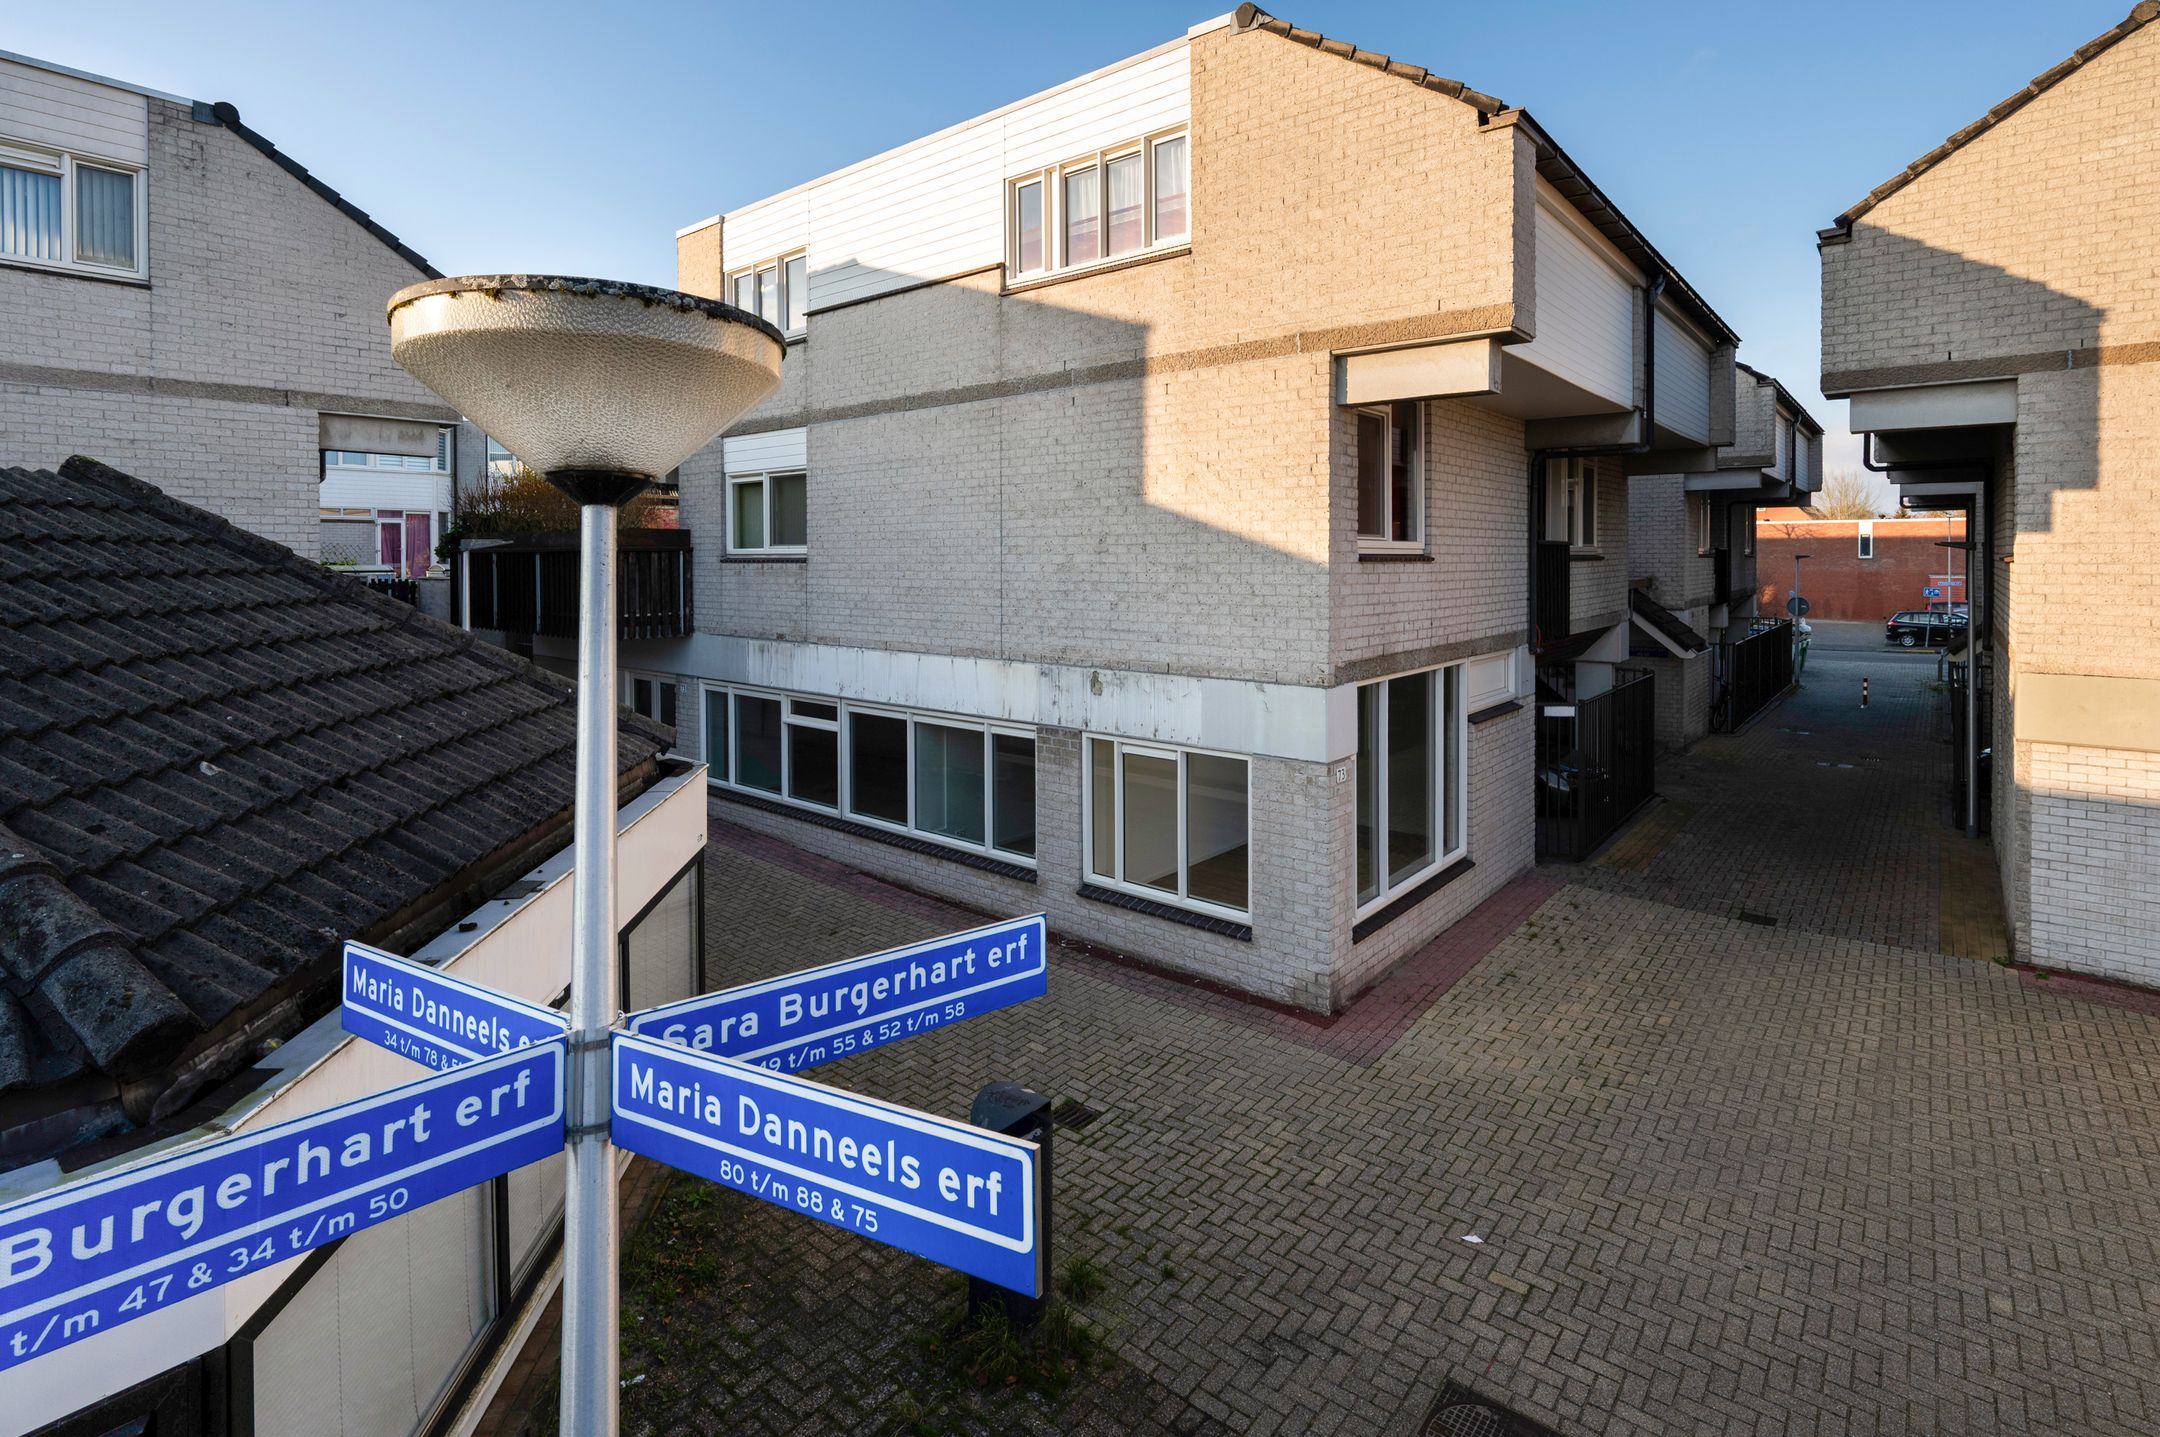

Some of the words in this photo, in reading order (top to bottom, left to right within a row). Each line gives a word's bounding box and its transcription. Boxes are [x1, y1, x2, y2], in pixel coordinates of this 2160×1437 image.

[1337, 768, 1346, 782] 73
[353, 965, 403, 1012] Maria
[412, 986, 510, 1051] Danneels
[662, 1011, 759, 1051] Sara
[779, 946, 976, 1028] Burgerhart
[987, 933, 1028, 968] erf
[788, 1046, 826, 1068] t/m
[833, 1034, 856, 1055] 55
[862, 1029, 874, 1046] &
[879, 1021, 901, 1041] 52
[906, 1012, 939, 1032] t/m
[945, 1001, 965, 1020] 58
[384, 1030, 398, 1049] 34
[400, 1037, 421, 1059] t/m
[423, 1046, 438, 1066] 78
[441, 1054, 449, 1070] &
[0, 1103, 431, 1289] Burgerhart
[455, 1069, 532, 1127] erf
[631, 1062, 721, 1126] Maria
[738, 1094, 921, 1190] Danneels
[938, 1167, 1002, 1216] erf
[720, 1159, 745, 1184] 80
[750, 1170, 789, 1202] t/m
[796, 1186, 823, 1213] 88
[830, 1198, 845, 1222] &
[851, 1203, 879, 1233] 75
[9, 1309, 99, 1357] t/m
[118, 1273, 174, 1313] 47
[187, 1262, 213, 1289] &
[227, 1236, 276, 1273] 34
[289, 1212, 356, 1250] t/m
[369, 1188, 409, 1219] 50
